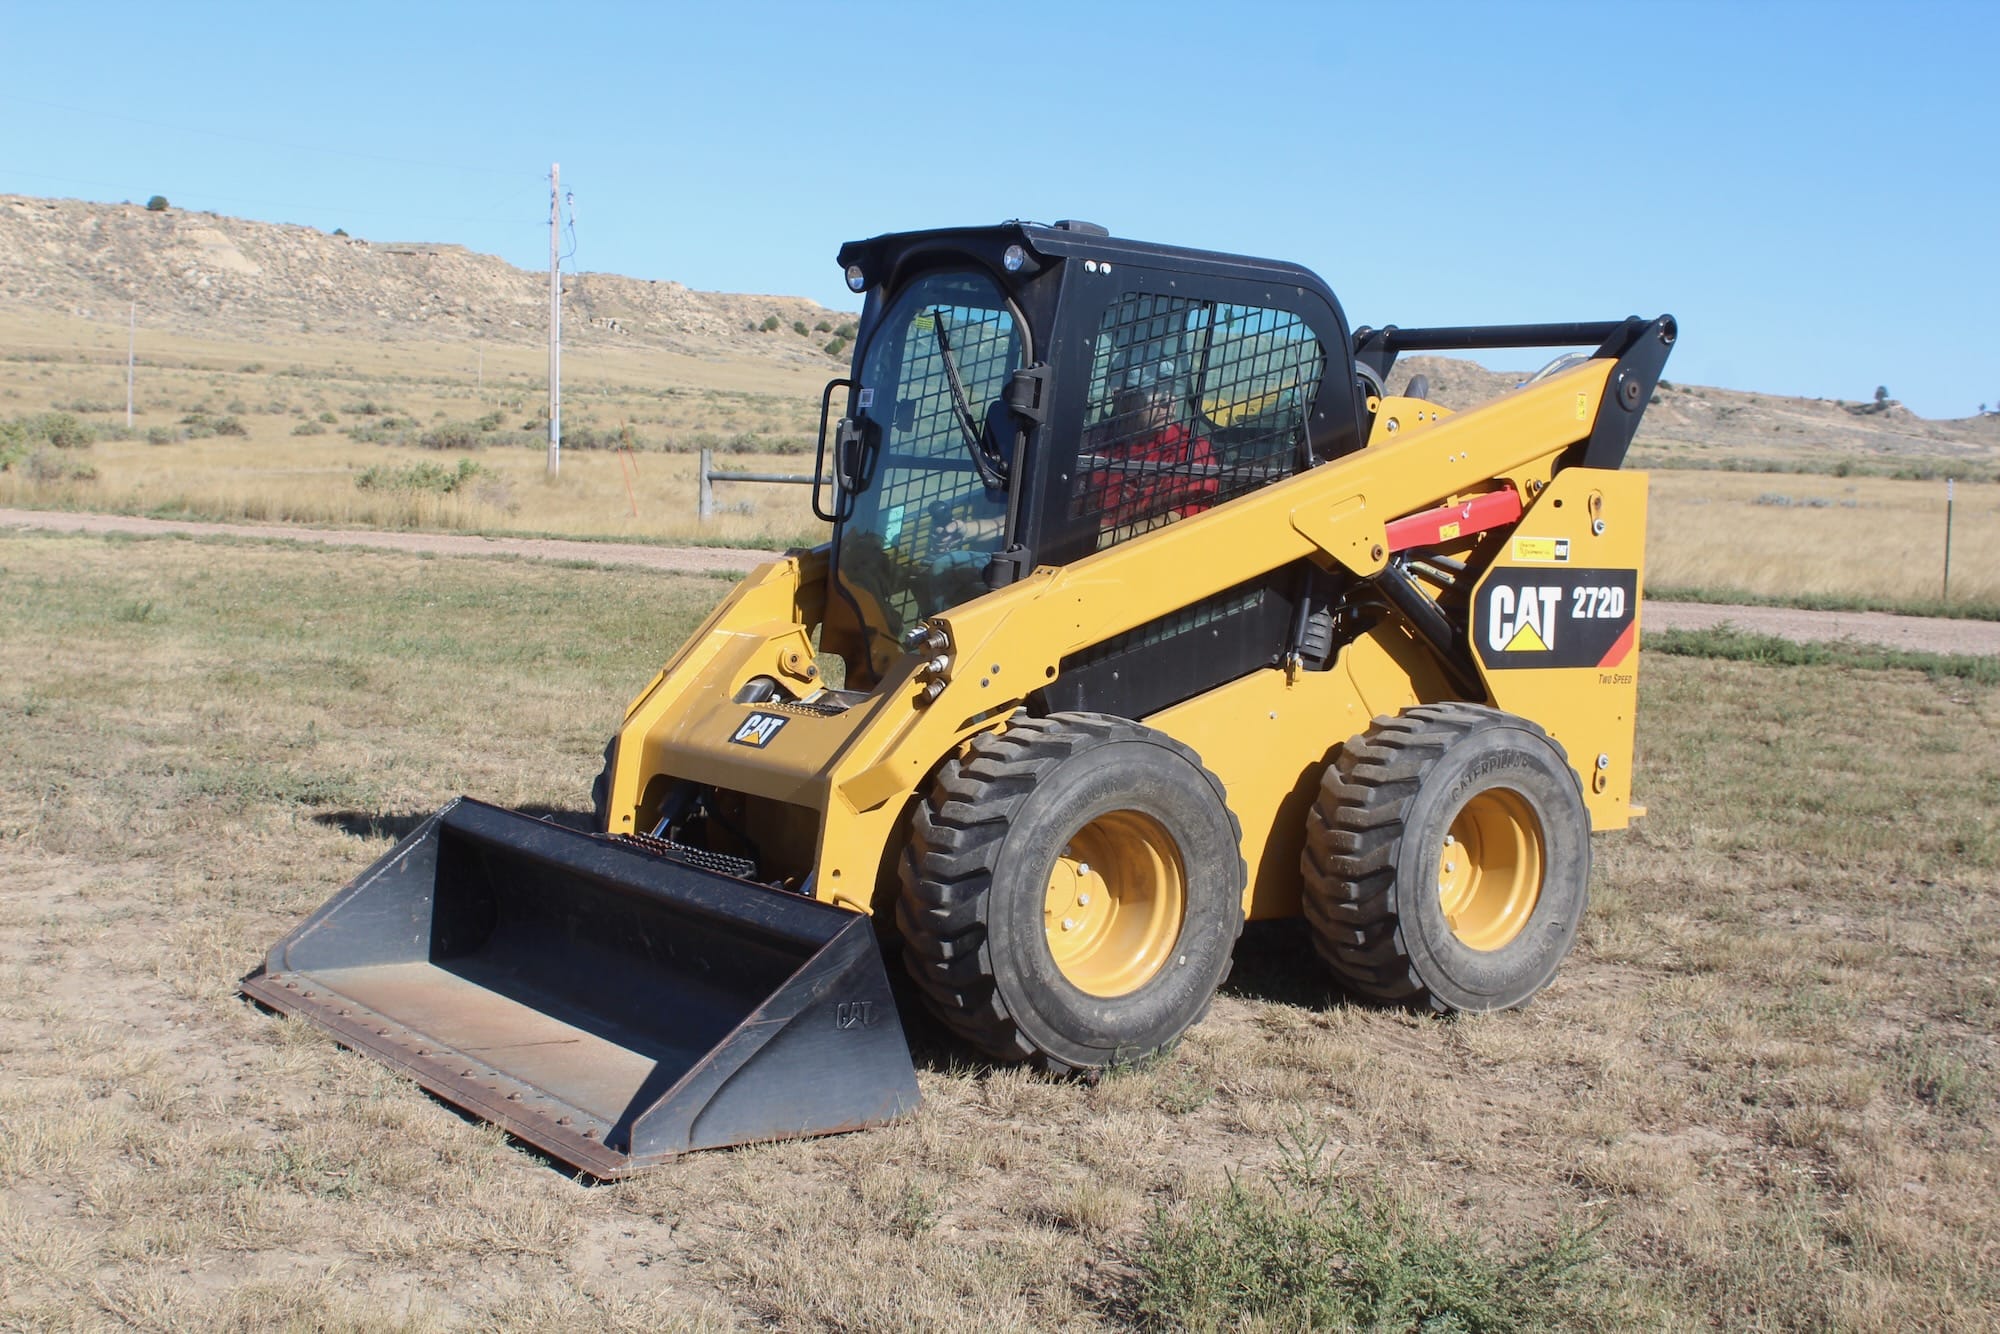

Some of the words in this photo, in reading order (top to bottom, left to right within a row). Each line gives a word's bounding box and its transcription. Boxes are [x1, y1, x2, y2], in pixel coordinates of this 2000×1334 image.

[1488, 584, 1562, 651] CAT
[1572, 586, 1625, 619] 272D
[735, 714, 785, 745] CAT
[836, 1001, 872, 1030] CAT
